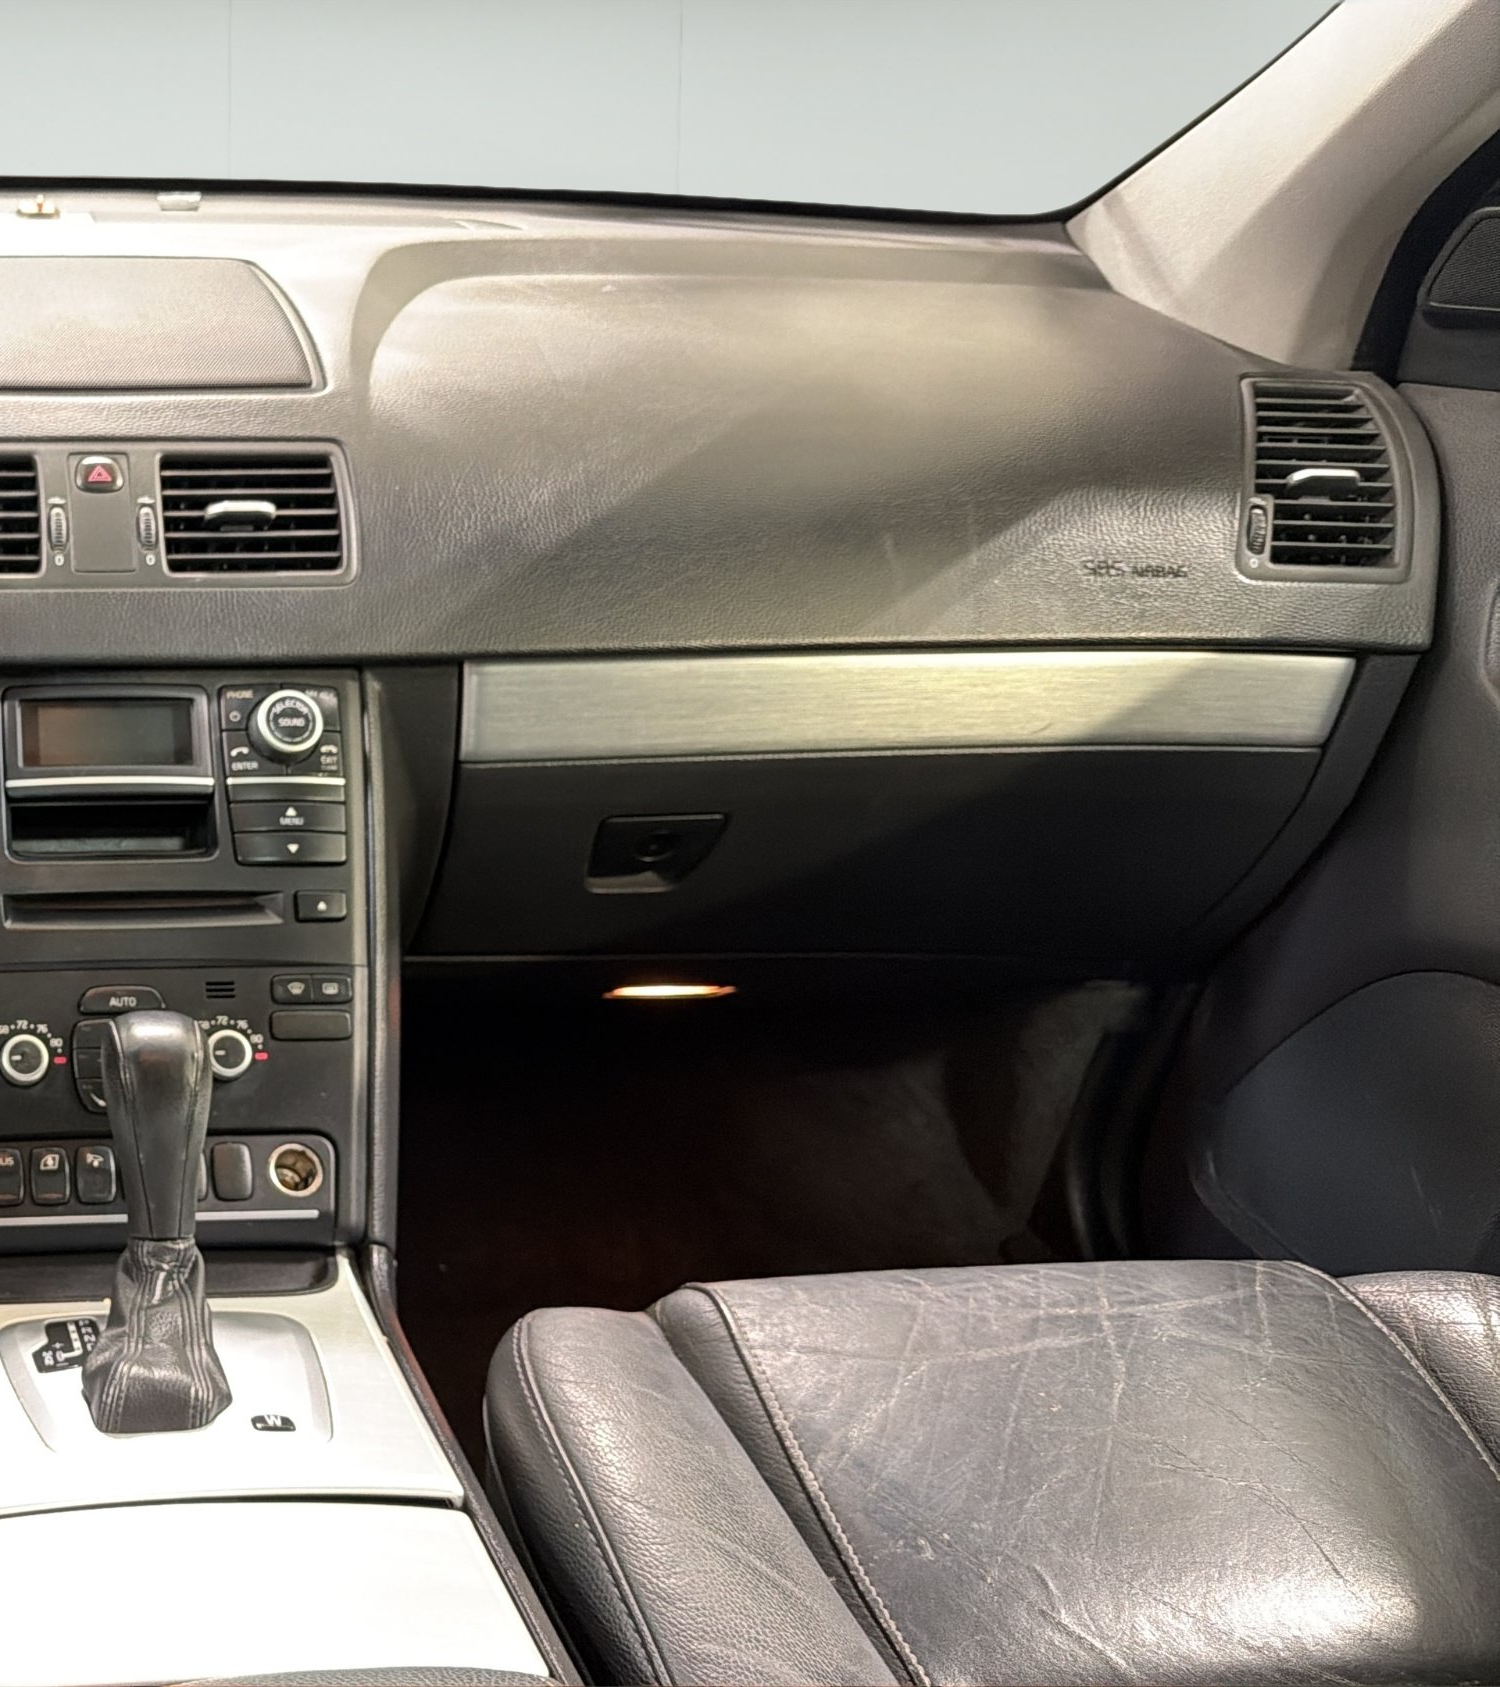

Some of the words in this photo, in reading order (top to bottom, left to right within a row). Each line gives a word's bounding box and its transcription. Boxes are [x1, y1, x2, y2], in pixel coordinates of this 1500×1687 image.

[226, 689, 254, 699] PHONE
[273, 699, 309, 714] SELECTOR
[278, 717, 305, 727] SOUND
[231, 761, 258, 771] ENTER
[279, 817, 304, 825] MENU
[109, 997, 137, 1007] AUTO
[16, 1020, 28, 1030] 72
[216, 1016, 229, 1025] 72
[236, 1019, 249, 1029] 76
[36, 1024, 49, 1033] 76
[50, 1038, 63, 1048] 80
[250, 1034, 264, 1044] 80
[264, 1415, 282, 1427] W
